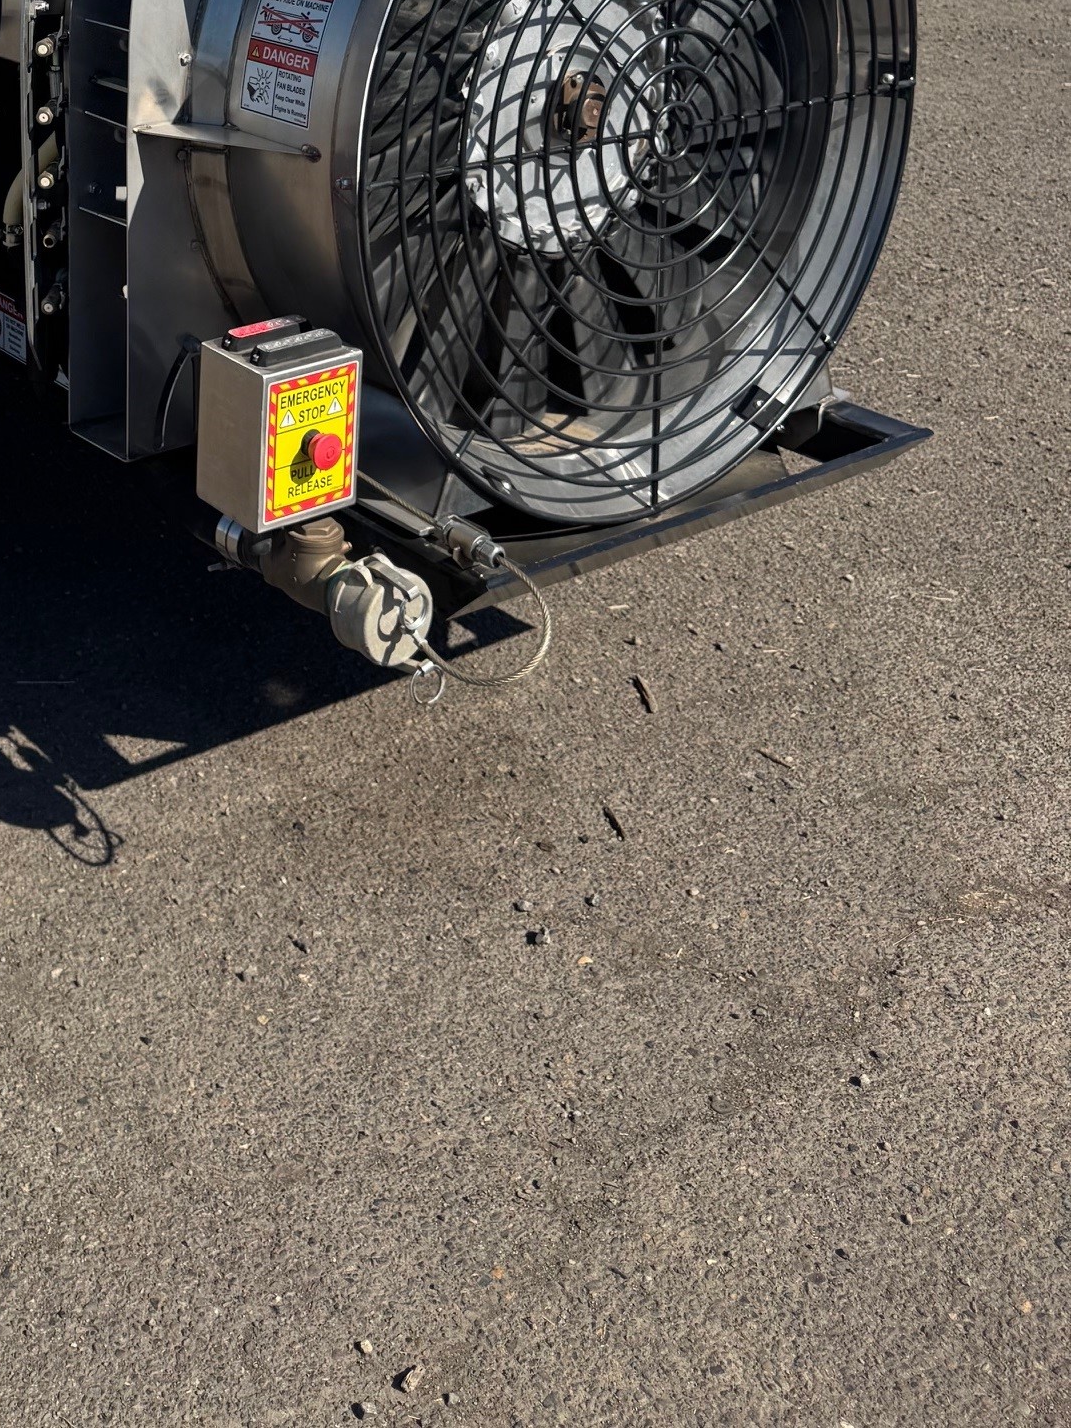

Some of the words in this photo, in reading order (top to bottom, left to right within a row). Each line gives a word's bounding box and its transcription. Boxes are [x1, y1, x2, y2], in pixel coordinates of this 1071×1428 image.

[304, 0, 329, 13] MACHINE
[262, 46, 310, 71] DANGER
[277, 70, 302, 83] ROTATING
[276, 81, 286, 90] FAN
[286, 84, 306, 96] BLADES
[280, 379, 346, 410] EMERGENCY
[298, 404, 327, 424] STOP
[290, 465, 315, 481] PULL
[287, 474, 333, 499] RELEASE
